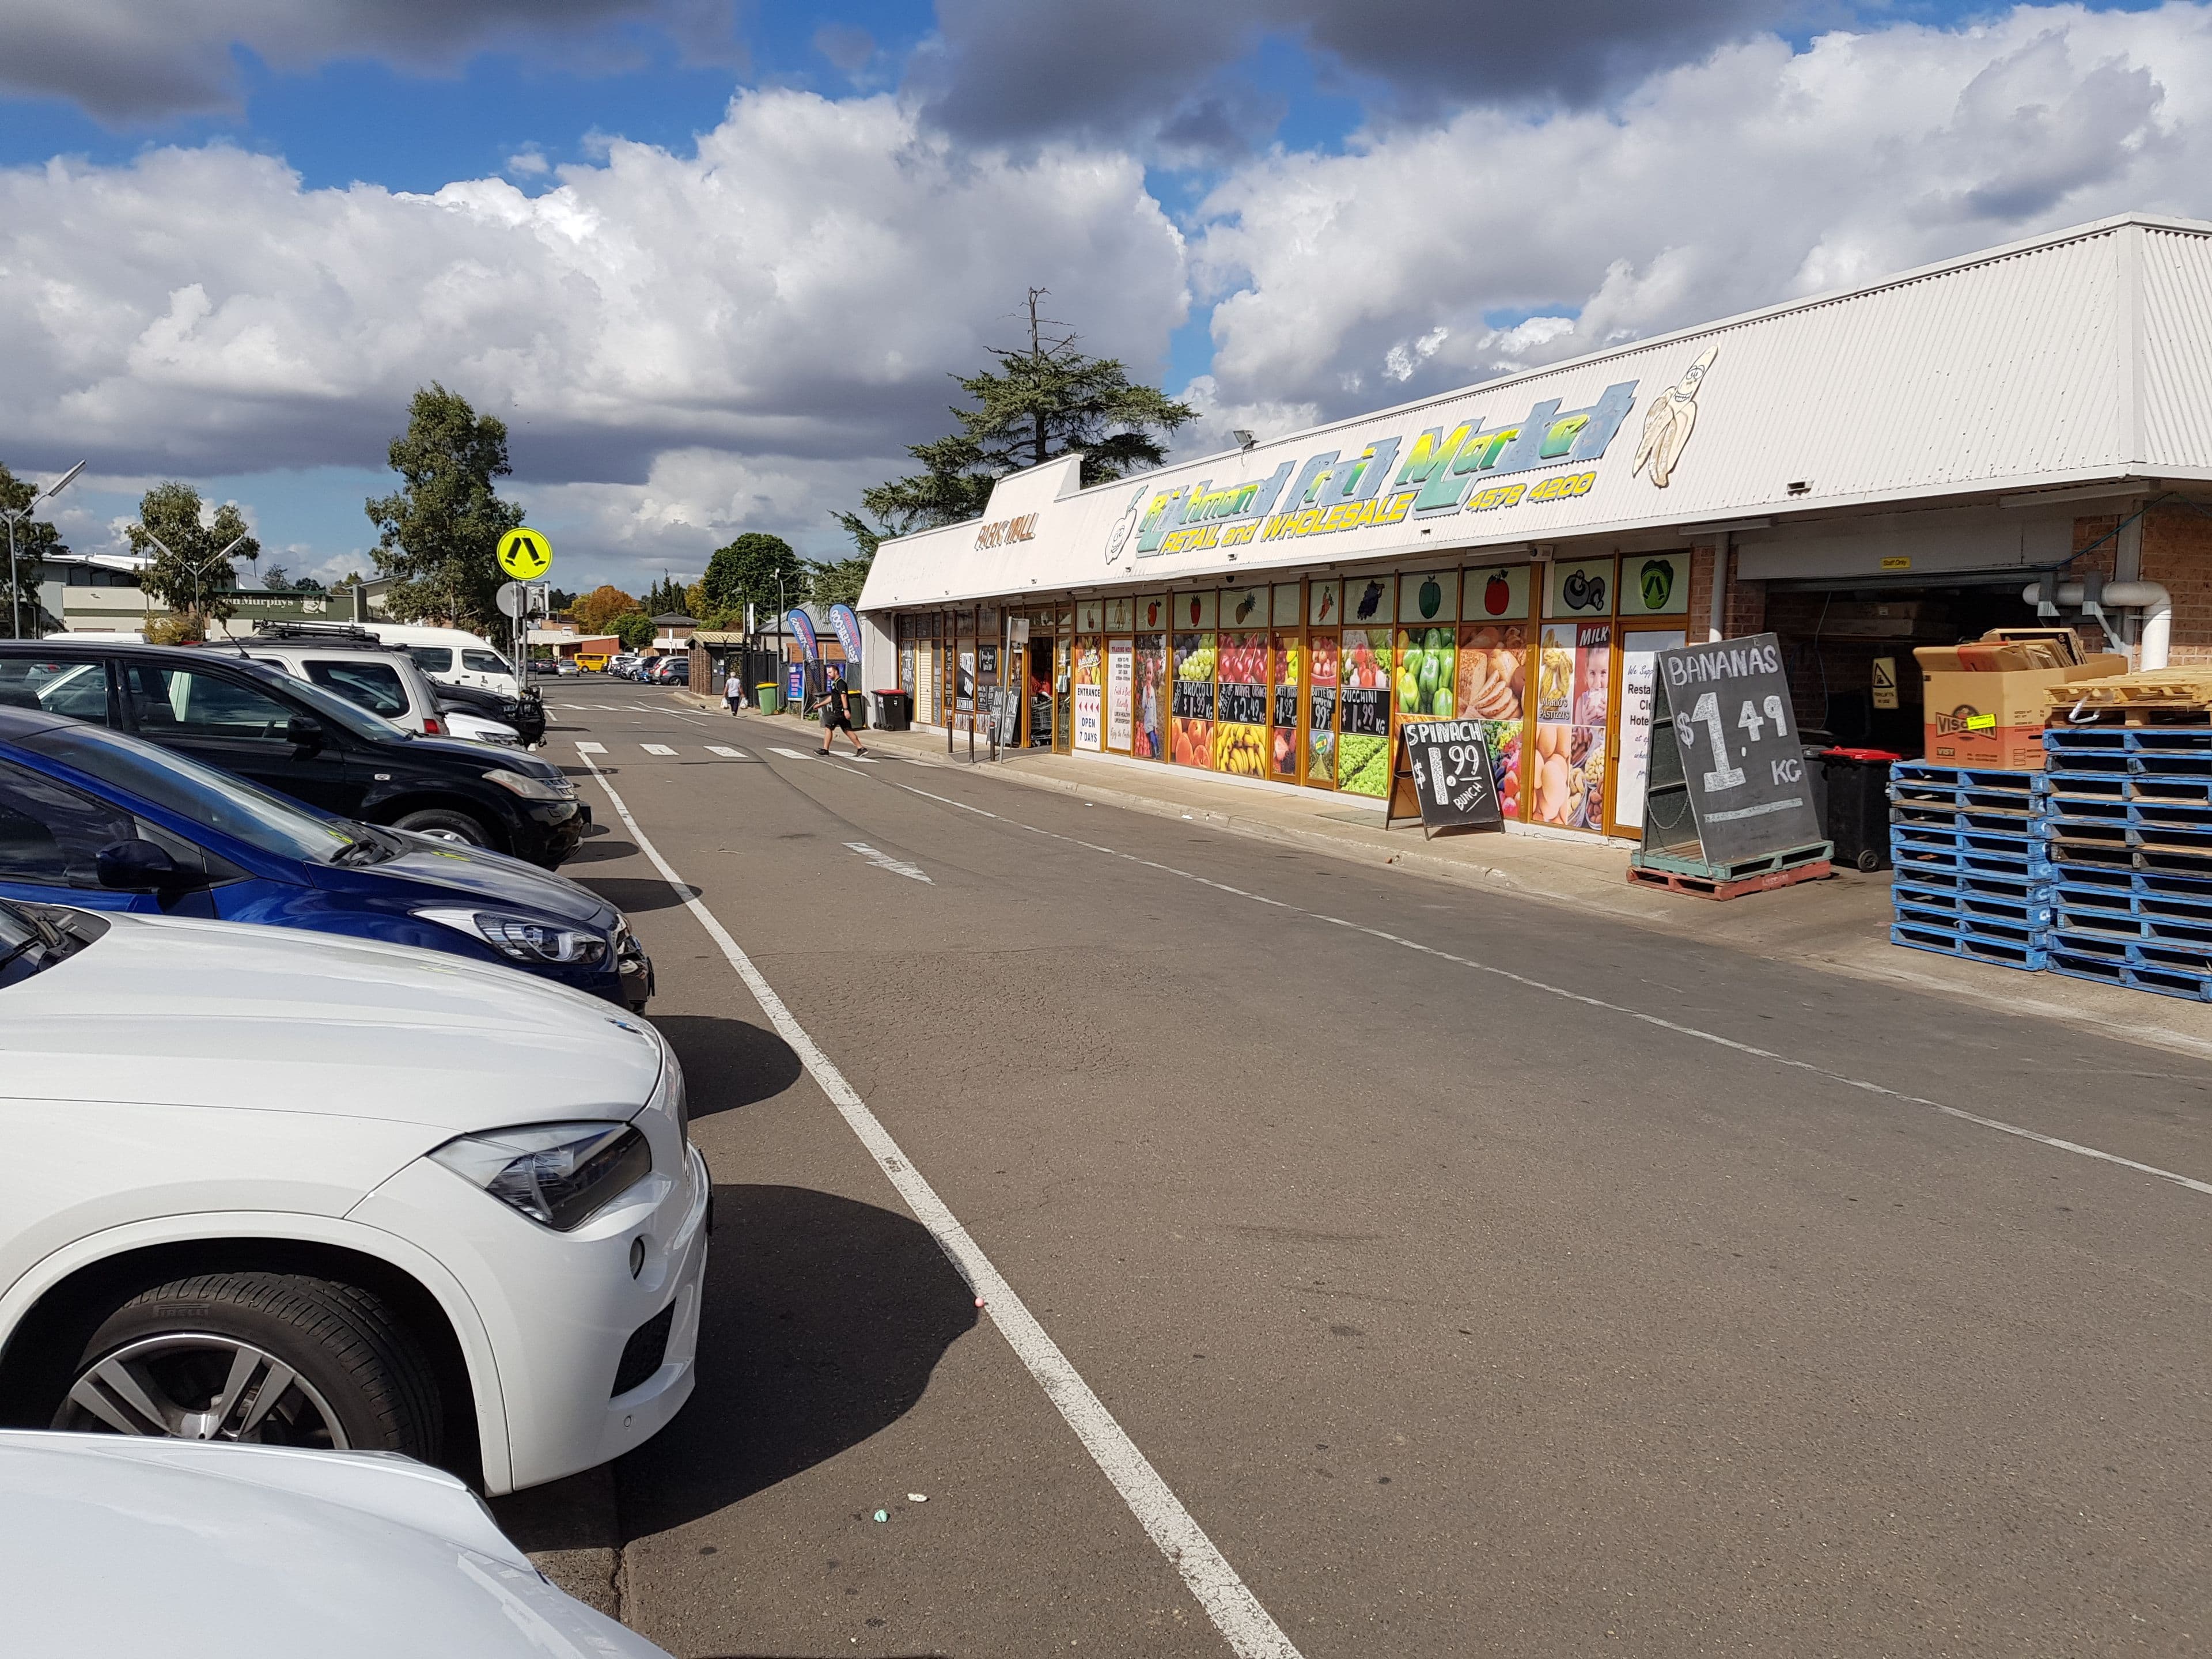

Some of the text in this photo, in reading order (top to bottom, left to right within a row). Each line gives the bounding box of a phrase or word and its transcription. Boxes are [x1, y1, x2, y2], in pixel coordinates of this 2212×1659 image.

[1466, 471, 1596, 512] 4578 4200
[1136, 460, 1297, 556] Rihmon
[974, 512, 1039, 551] PARK MALL
[1160, 490, 1418, 555] RETAIL and WHOLESALE
[790, 618, 808, 647] GOURMET
[1580, 626, 1609, 647] MILK
[1628, 665, 1637, 675] We
[1668, 644, 1779, 687] BANANAS
[1077, 687, 1101, 698] ENTRANCE
[1183, 682, 1213, 697] BROCCOLI
[1234, 685, 1251, 698] NAVEL
[1342, 690, 1377, 703] ZUCCHINI
[1206, 704, 1213, 719] KG
[1081, 717, 1096, 728] OPEN
[1376, 718, 1385, 734] KG
[1080, 732, 1097, 743] 7 DAYS
[1406, 721, 1483, 746] SPINACH
[1937, 748, 1955, 756] VISY
[1770, 759, 1802, 786] KG
[1453, 782, 1483, 811] BUNCH
